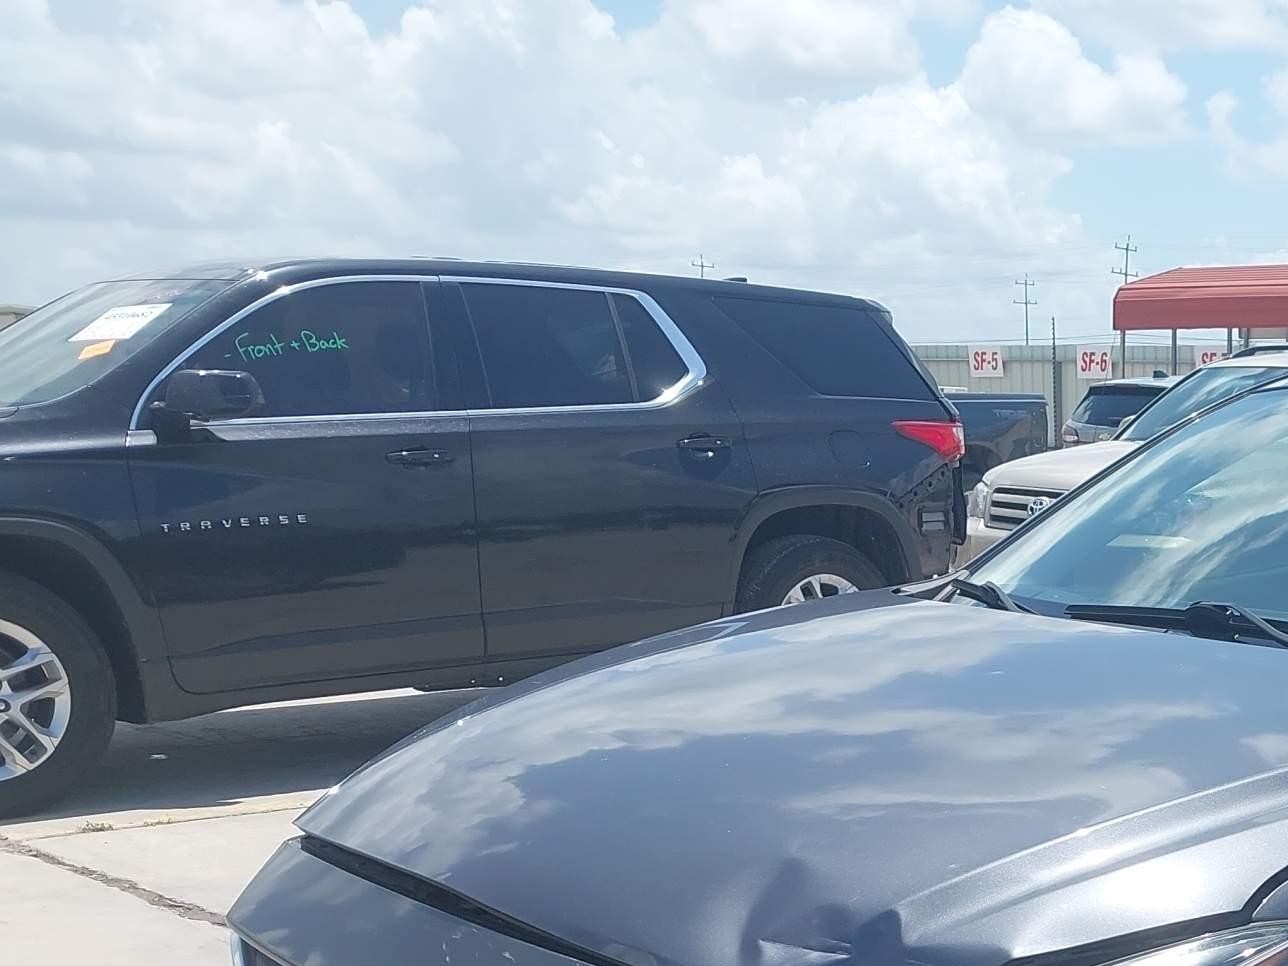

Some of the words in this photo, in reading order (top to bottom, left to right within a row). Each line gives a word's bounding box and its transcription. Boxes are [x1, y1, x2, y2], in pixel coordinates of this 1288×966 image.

[235, 332, 285, 362] Front
[290, 340, 301, 351] +
[300, 330, 349, 352] Back
[973, 351, 999, 372] SF-5
[1080, 351, 1108, 373] SF-6
[160, 514, 308, 533] TRAVERSE
